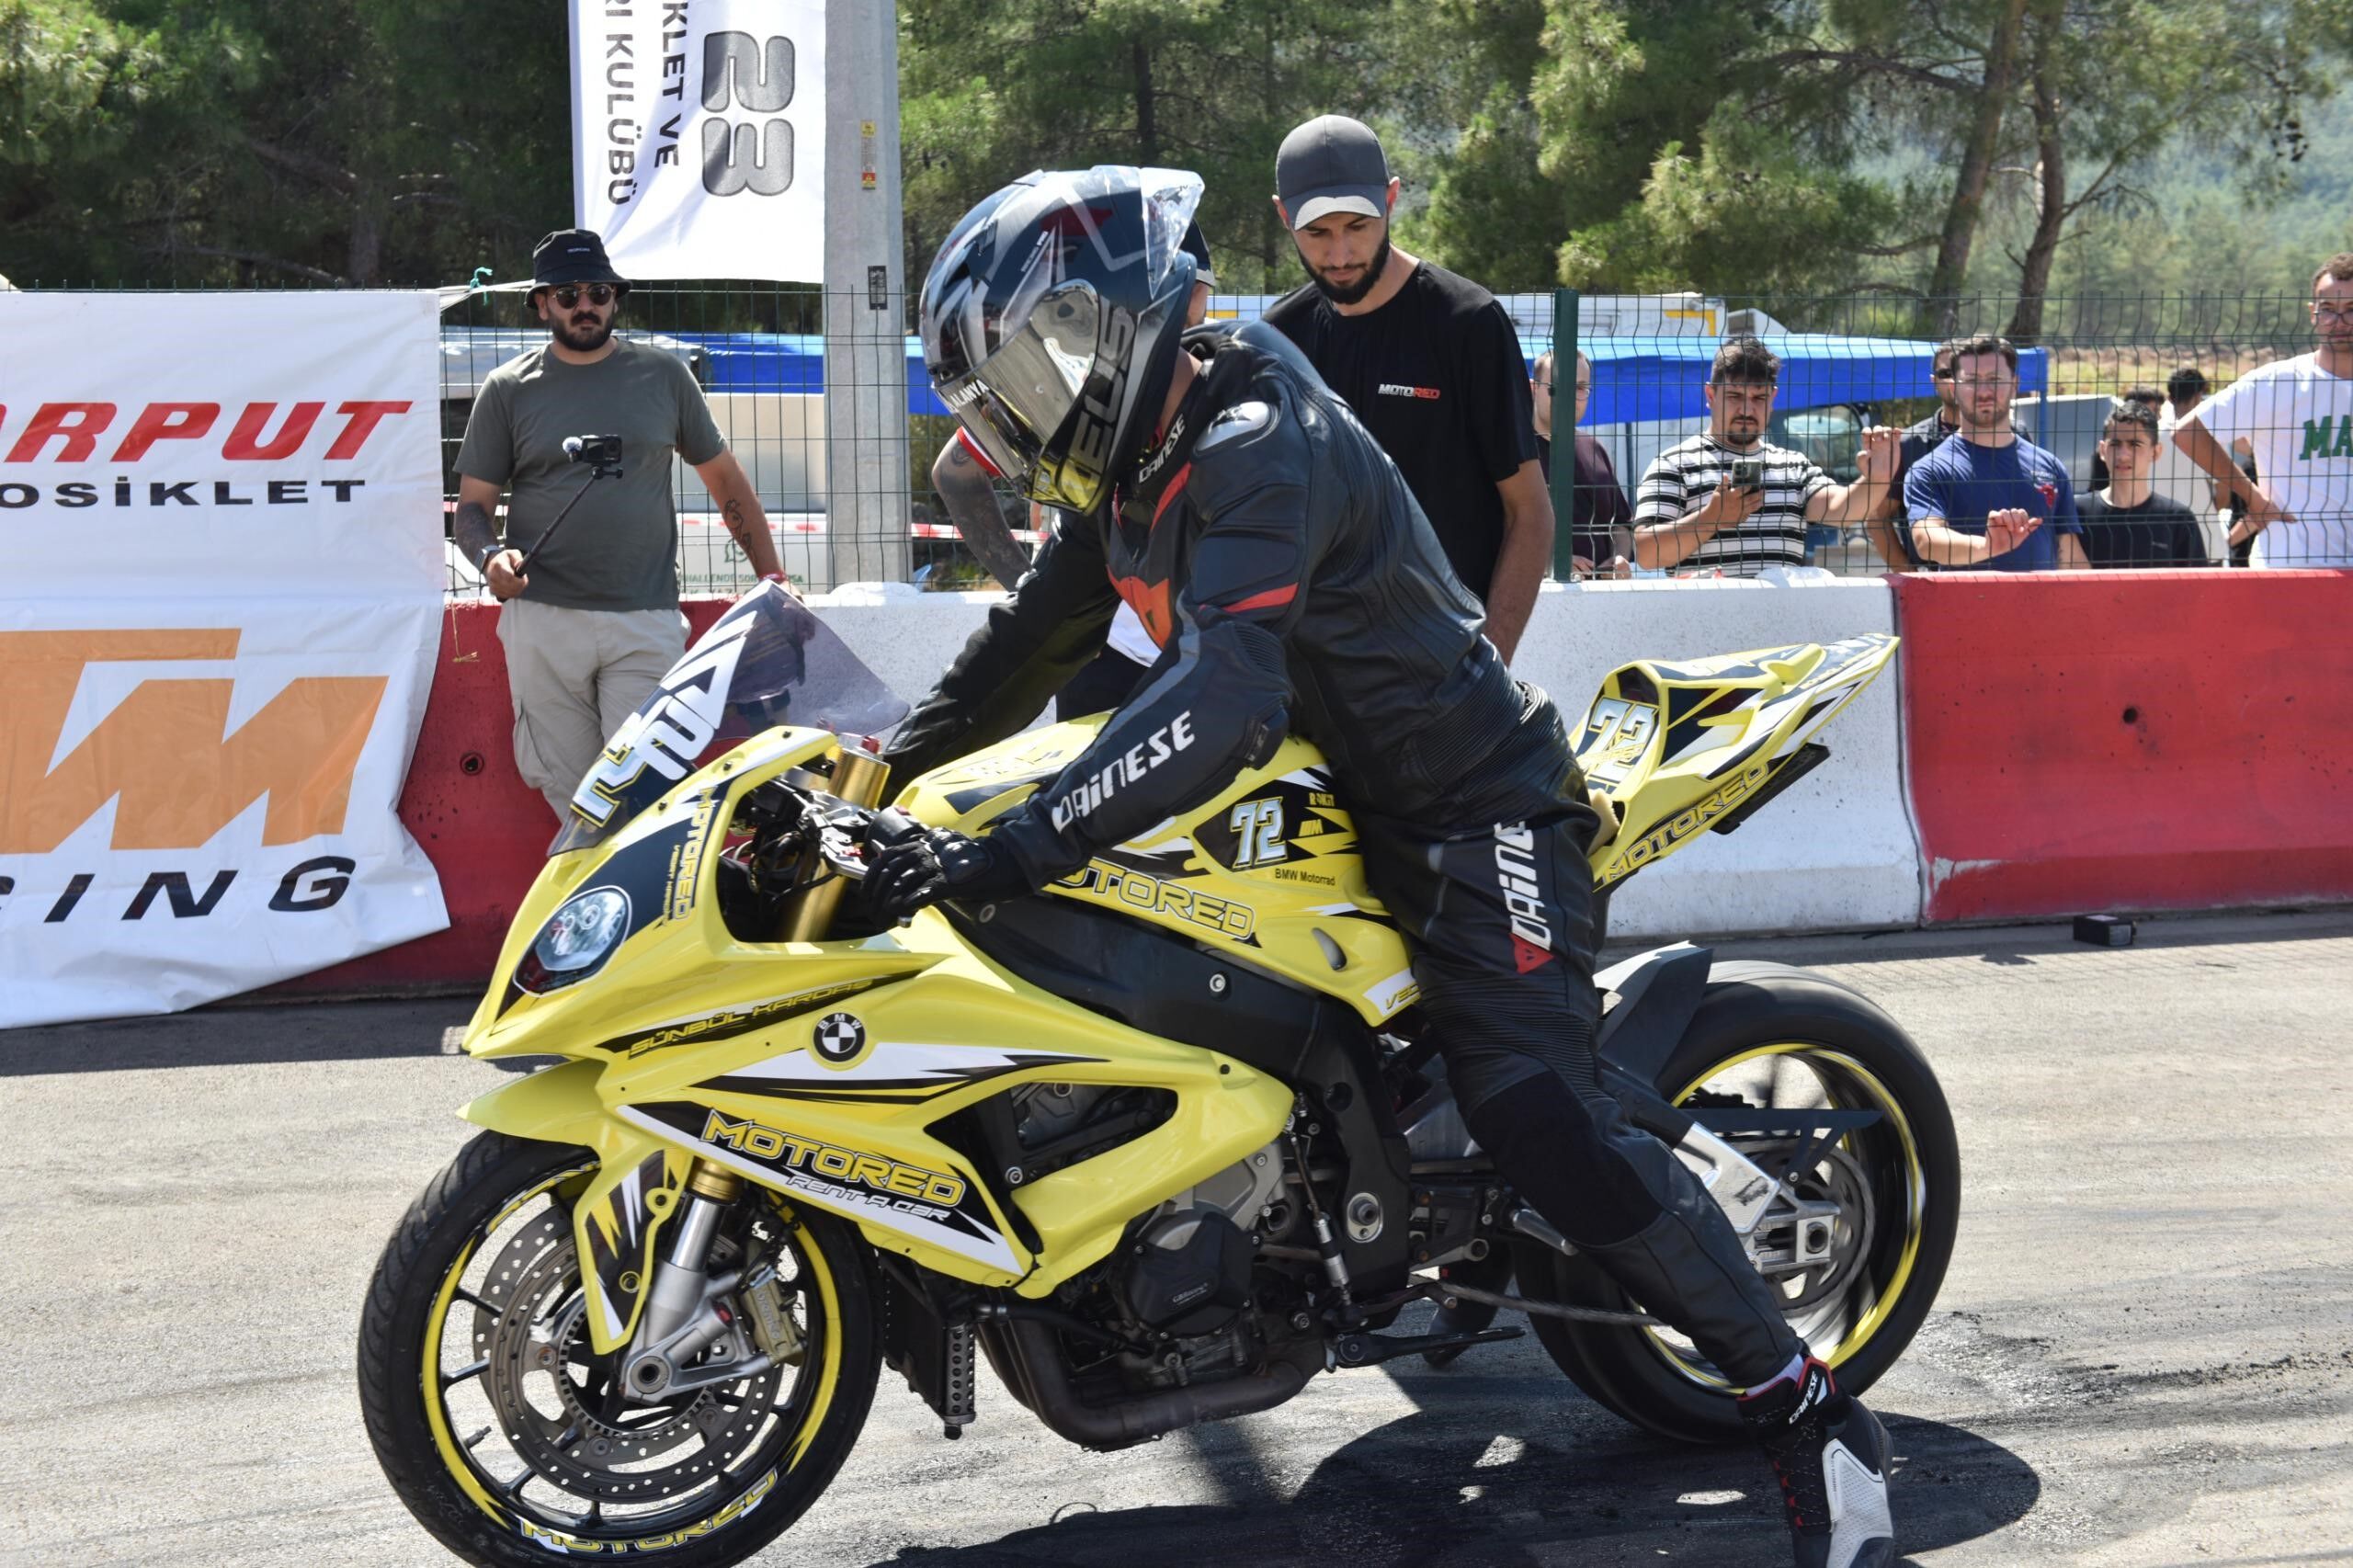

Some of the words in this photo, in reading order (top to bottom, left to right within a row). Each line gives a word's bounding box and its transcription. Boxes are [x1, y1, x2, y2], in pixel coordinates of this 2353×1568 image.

[606, 33, 642, 205] KULÜBÜ
[654, 113, 682, 168] VE
[1378, 383, 1441, 400] MOTORED
[0, 401, 414, 462] RPUT
[1139, 415, 1187, 483] DAINESE
[1051, 710, 1195, 835] DAINESE
[673, 784, 721, 919] MOTORED
[1230, 796, 1289, 869] 72
[1602, 762, 1769, 885] MOTORED
[0, 856, 357, 923] ING
[1275, 868, 1298, 881] BMW
[1300, 871, 1336, 886] Motorrad
[699, 1108, 966, 1208] MOTORED
[1788, 1370, 1819, 1425] DAINESE
[520, 1468, 779, 1554] MOTORED
